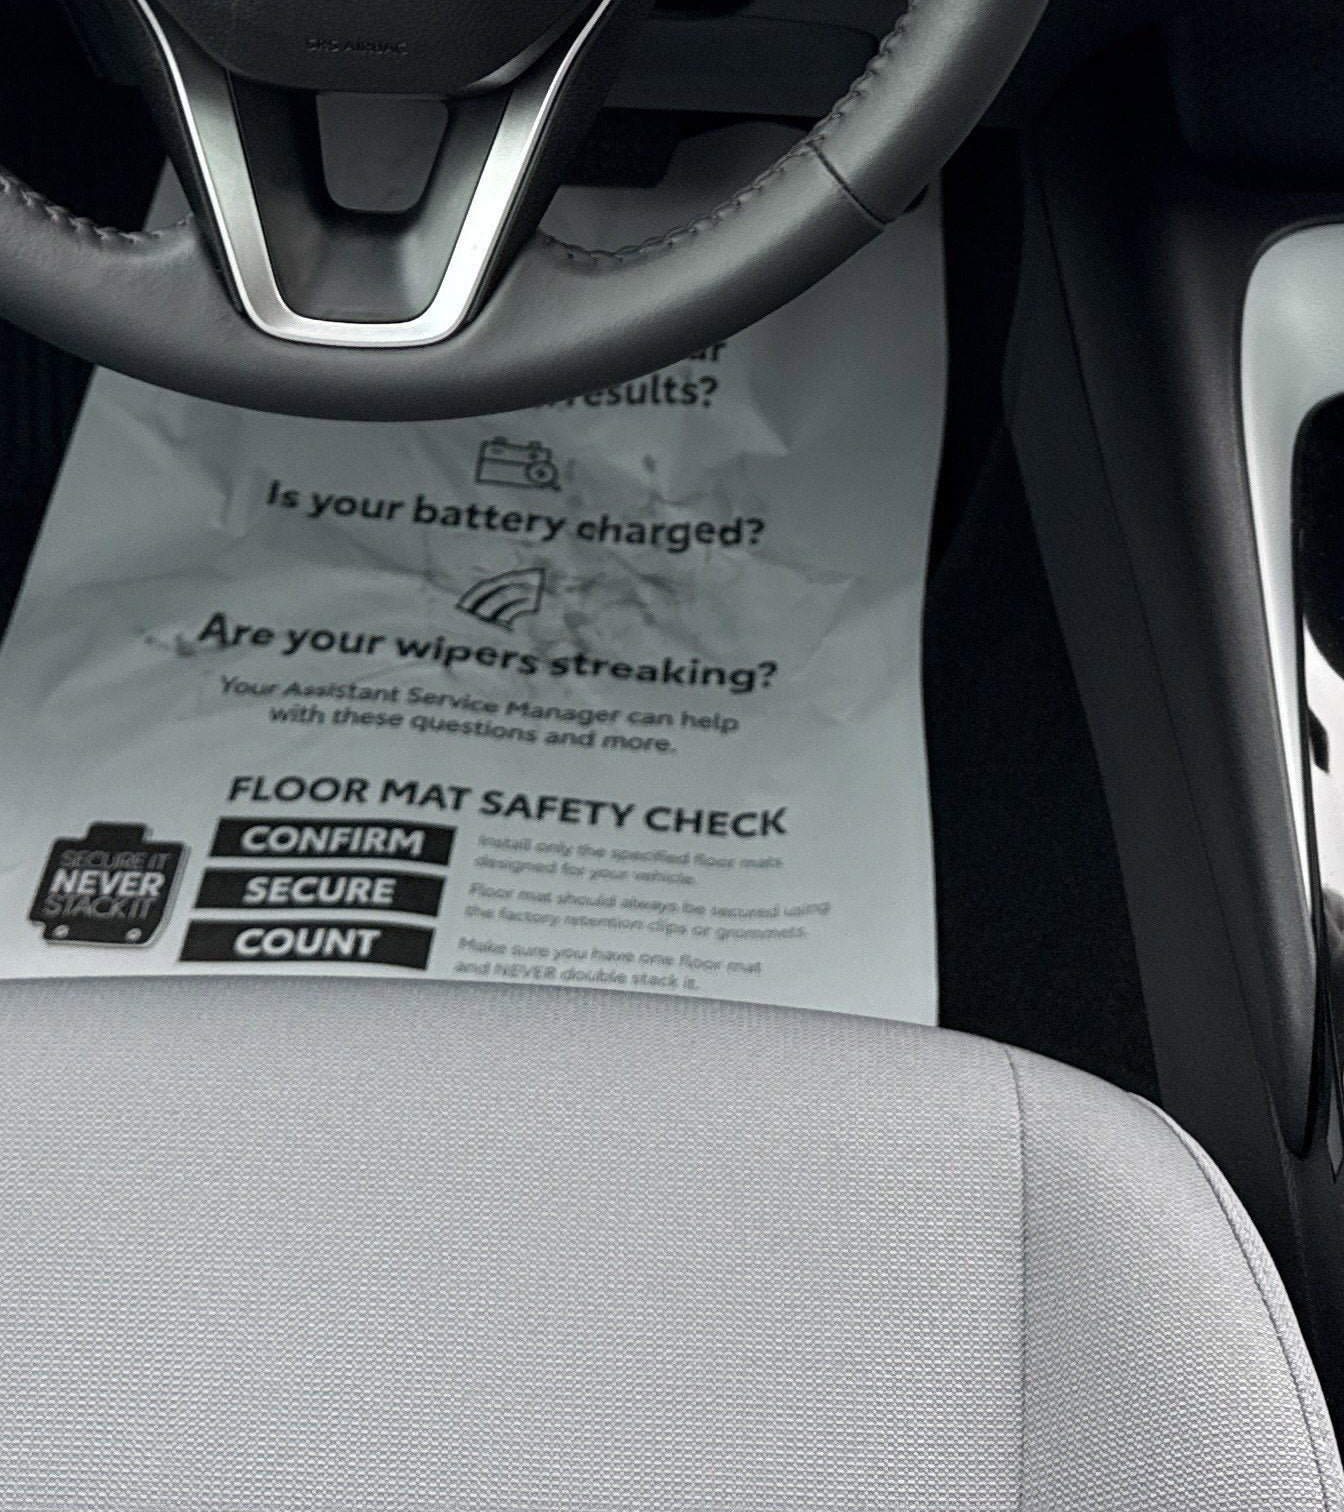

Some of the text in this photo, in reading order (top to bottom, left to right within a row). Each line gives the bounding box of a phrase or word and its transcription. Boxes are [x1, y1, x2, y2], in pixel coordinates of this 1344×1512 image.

[267, 480, 765, 555] Is your battery charged?
[199, 611, 778, 695] Are your wipers streaking?
[221, 675, 740, 735] Your Assistant Service Manager can help
[269, 703, 677, 756] with these questions and more.
[228, 775, 789, 838] FLOOR MAT SAFETY CHECK
[240, 825, 427, 858] CONFIRM
[576, 843, 606, 858] the
[59, 848, 173, 870] SECURE IT
[561, 861, 586, 877] for
[589, 867, 629, 881] your
[50, 868, 165, 898] NEVER
[242, 876, 397, 906] SECURE
[42, 892, 126, 919] STACK
[517, 889, 552, 904] mat
[558, 891, 617, 909] should
[619, 897, 677, 915] always
[682, 900, 706, 914] be
[710, 903, 781, 919] secured
[464, 904, 495, 919] the
[499, 906, 560, 927] factory
[691, 925, 710, 937] or
[233, 928, 382, 958] COUNT
[458, 937, 762, 974] Make sure you have one floor mat
[455, 960, 492, 975] and
[493, 962, 557, 980] NEVER
[559, 966, 629, 985] double
[630, 971, 678, 988] stack
